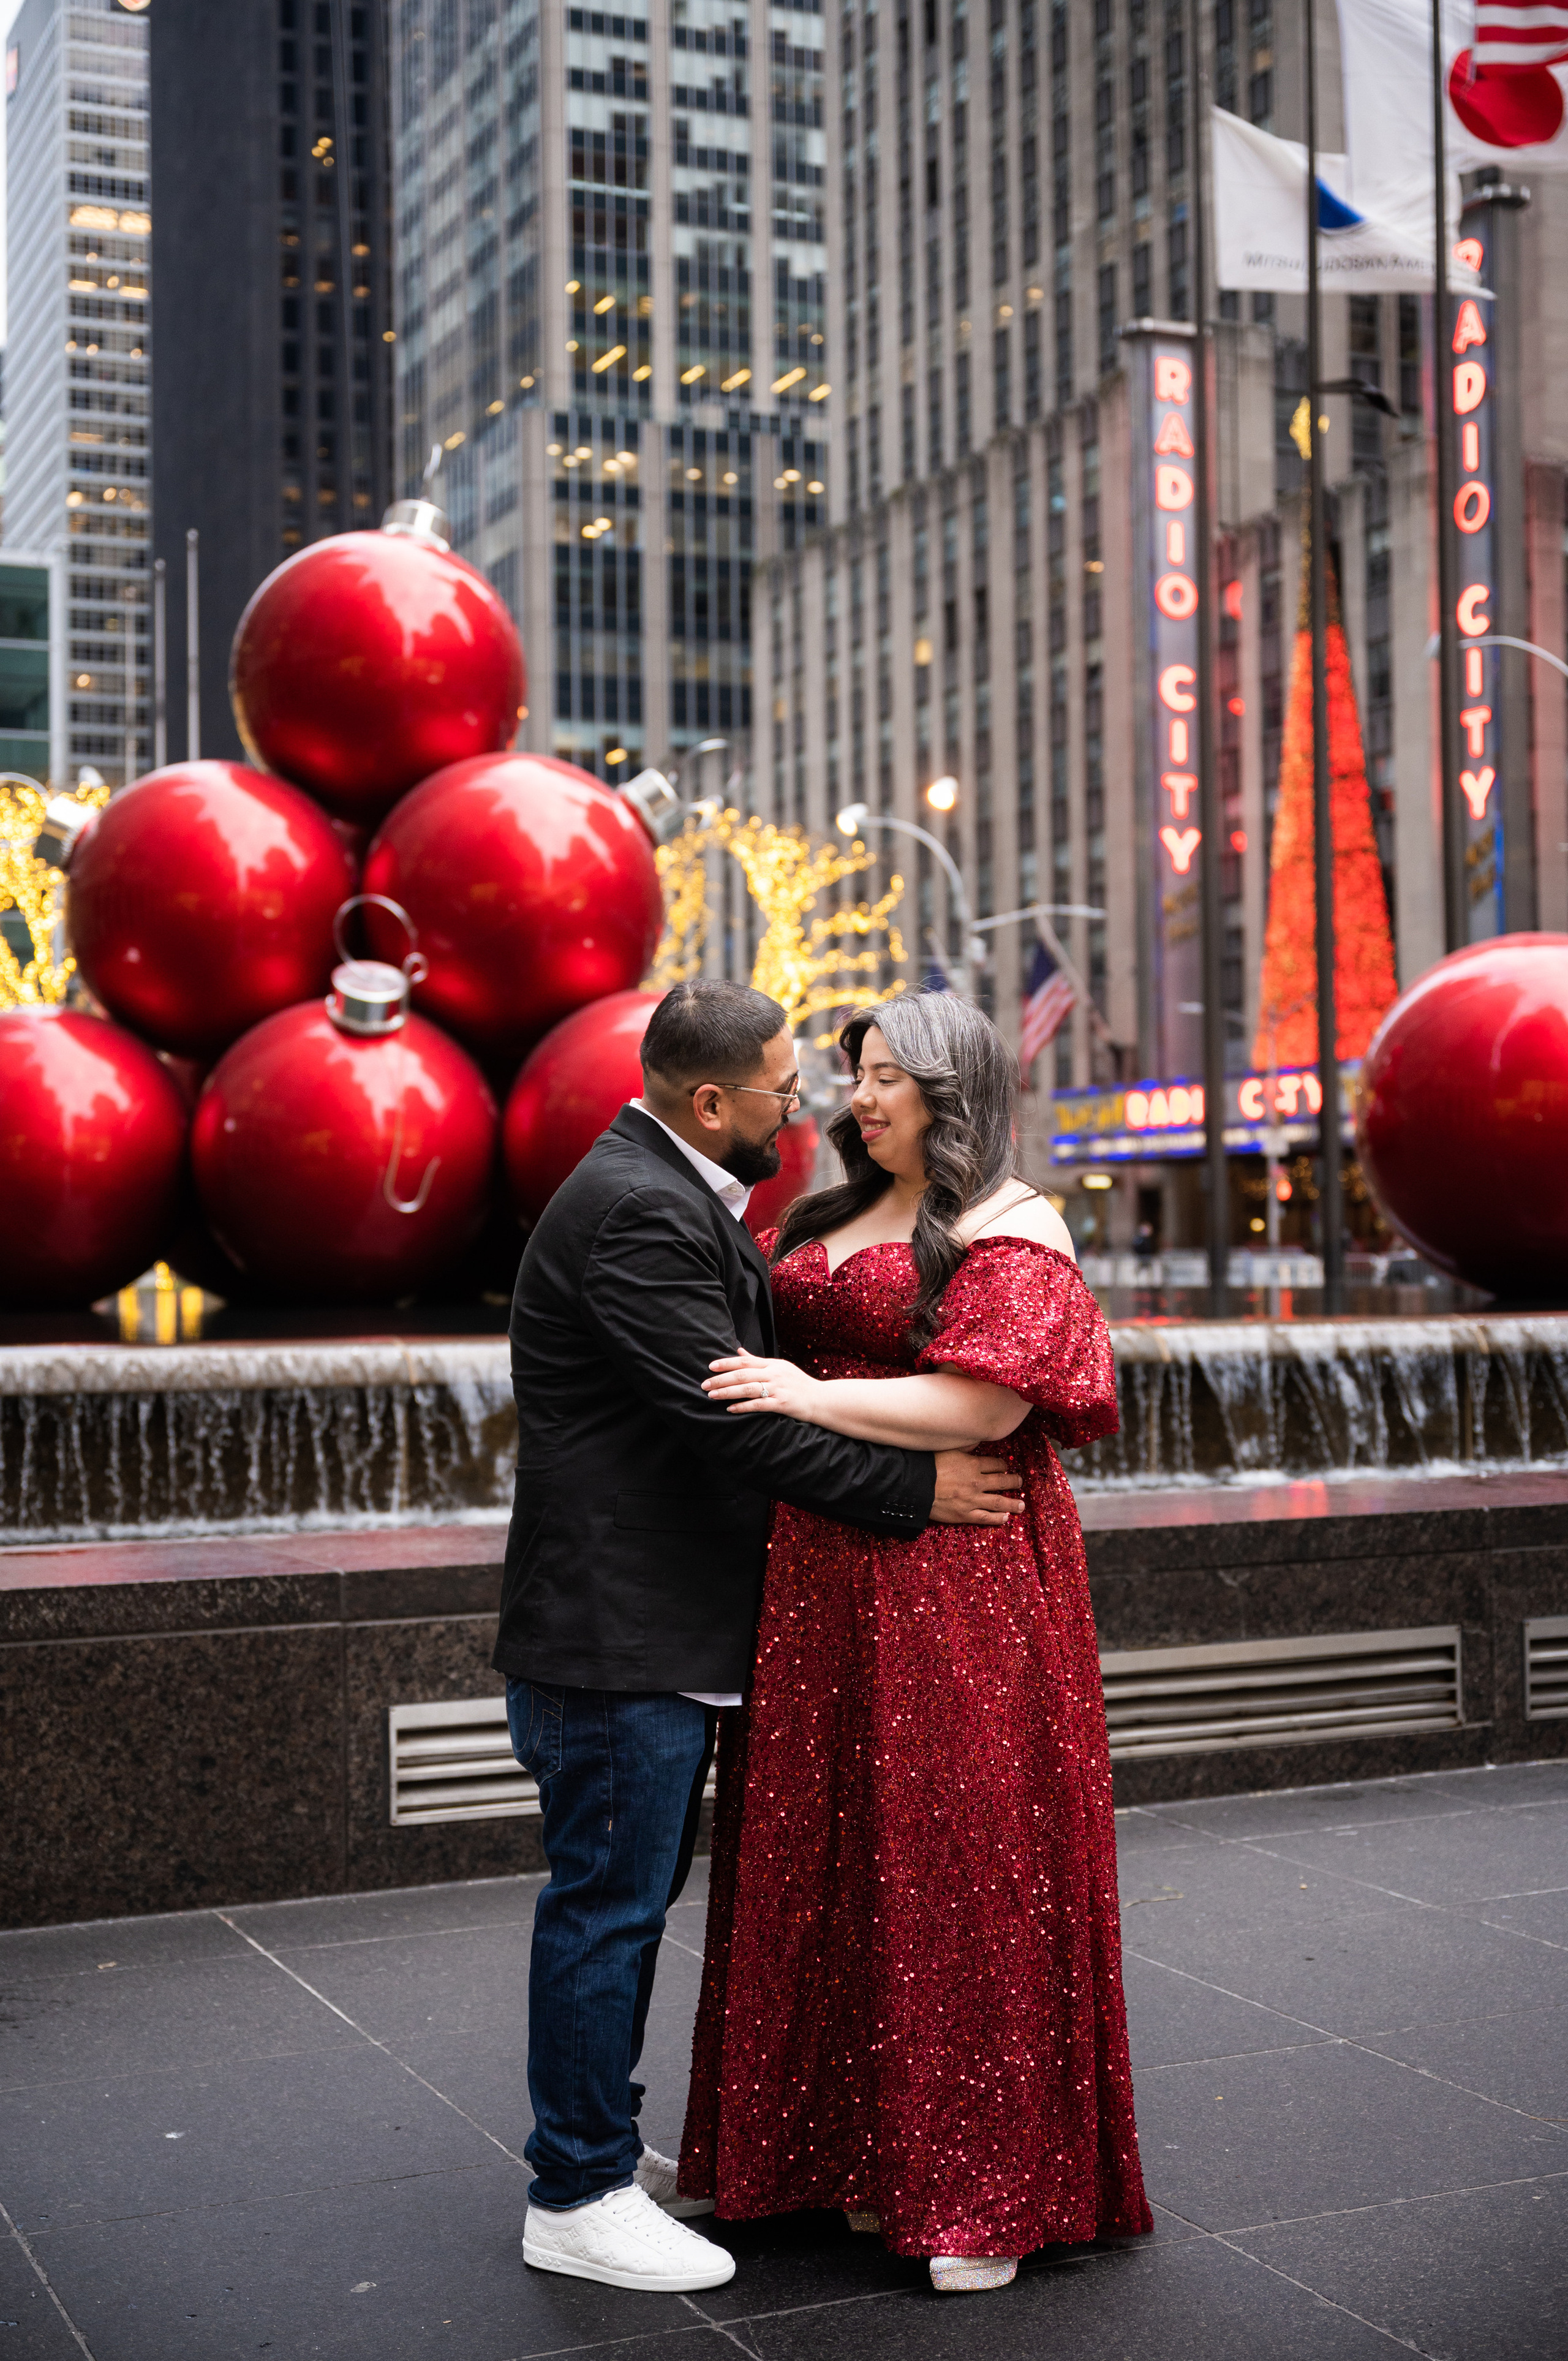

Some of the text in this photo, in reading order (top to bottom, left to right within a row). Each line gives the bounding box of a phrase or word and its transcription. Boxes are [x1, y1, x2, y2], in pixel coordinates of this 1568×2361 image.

[1155, 355, 1199, 621] RADIO
[1159, 664, 1202, 874] CITY
[1457, 584, 1496, 820] CITY
[1125, 1084, 1205, 1130] RADI
